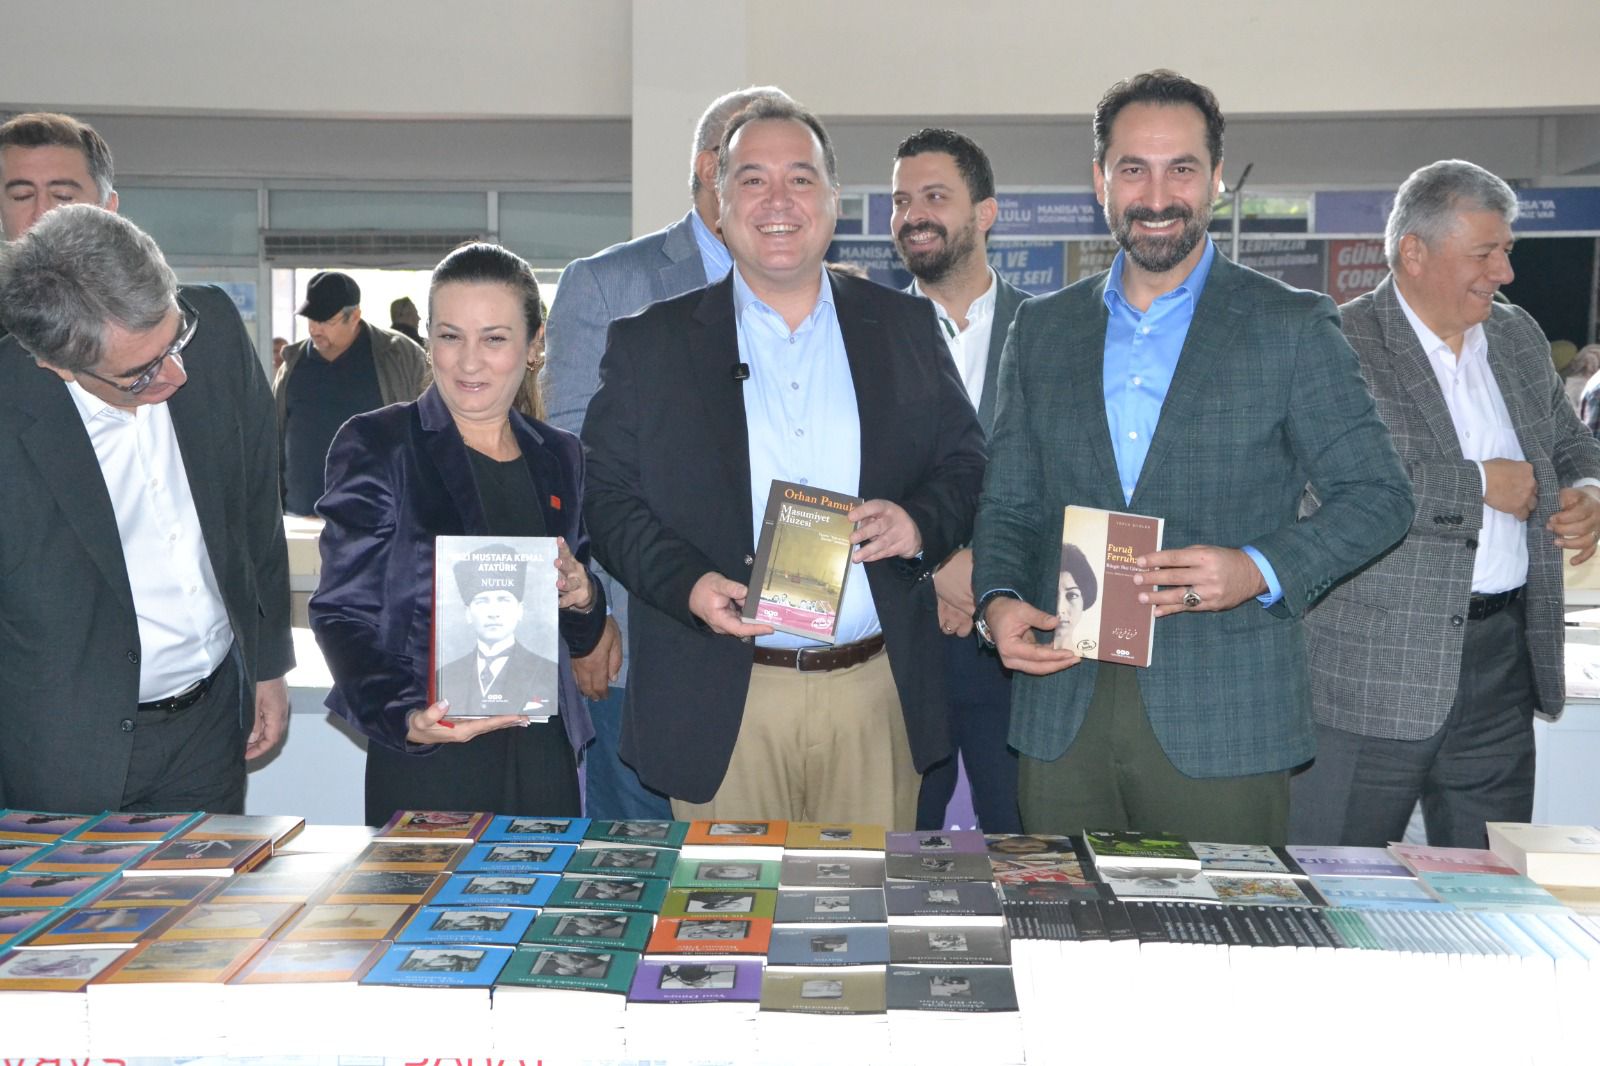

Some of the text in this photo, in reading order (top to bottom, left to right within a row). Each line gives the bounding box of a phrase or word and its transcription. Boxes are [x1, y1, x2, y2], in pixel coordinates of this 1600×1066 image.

[1007, 250, 1029, 268] VE
[1022, 266, 1053, 285] SETİ
[783, 488, 818, 505] Orhan
[779, 513, 813, 528] Müzesi
[780, 504, 831, 523] Masumiyet
[472, 553, 513, 562] MUSTAFA
[514, 553, 546, 562] KEMAL
[1106, 543, 1134, 557] Furuğ
[478, 561, 518, 572] ATATÜRK
[481, 578, 515, 588] NUTUK
